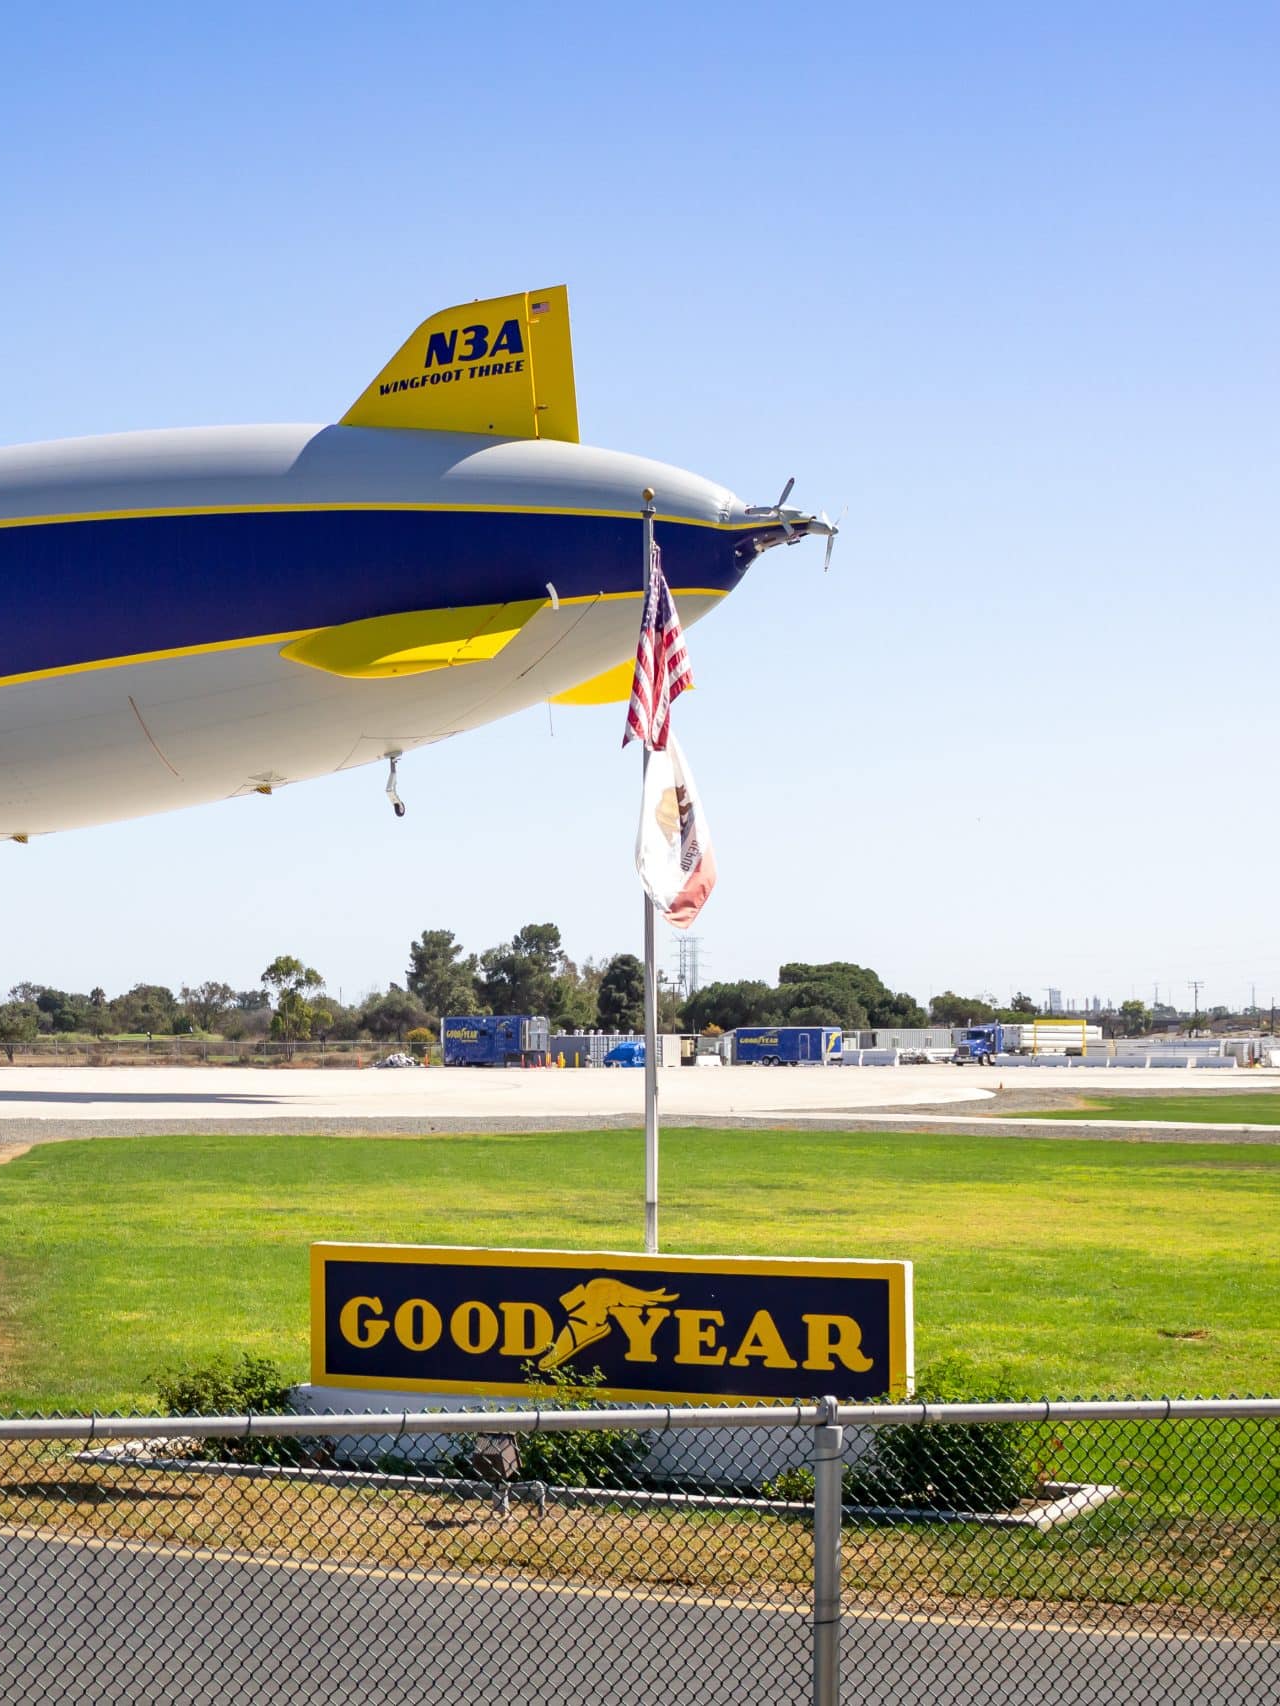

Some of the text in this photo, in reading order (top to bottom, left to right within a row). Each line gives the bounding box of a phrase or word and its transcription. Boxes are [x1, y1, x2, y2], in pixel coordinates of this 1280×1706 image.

[424, 319, 524, 369] N3A
[379, 359, 525, 396] WINGFOOT THREE
